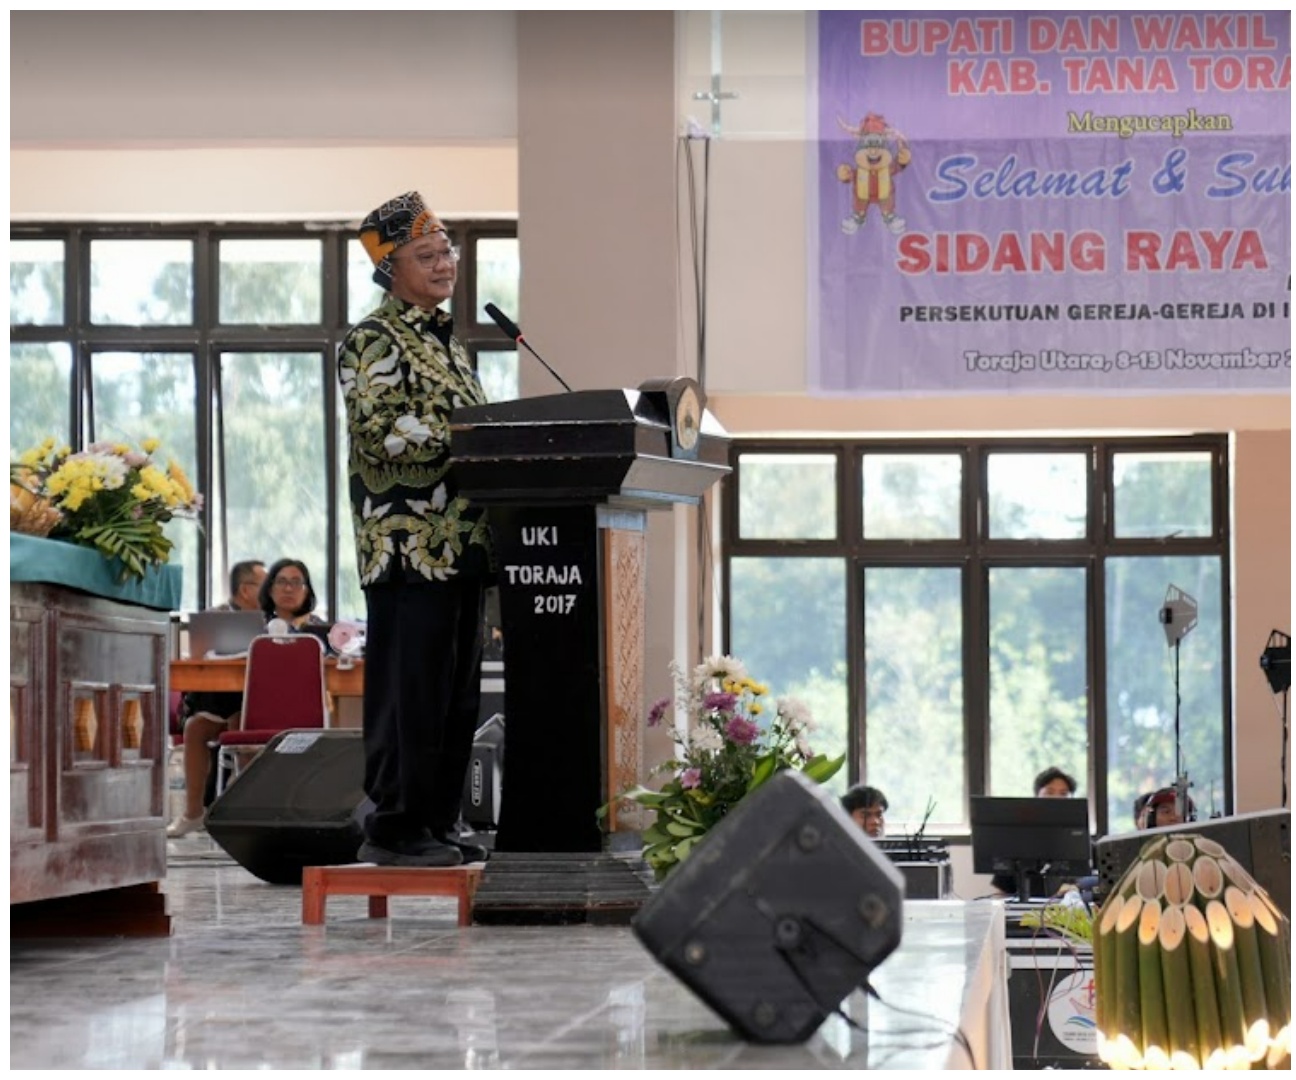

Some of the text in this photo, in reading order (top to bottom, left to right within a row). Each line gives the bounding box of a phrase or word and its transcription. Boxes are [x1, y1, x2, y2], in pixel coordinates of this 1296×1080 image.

[861, 14, 1277, 55] BUPATI DAN WAKIL
[948, 58, 1050, 95] KAB.
[1063, 57, 1177, 94] TANA
[1067, 108, 1234, 138] Mengucapkan
[928, 154, 1133, 203] Selamat
[1151, 147, 1189, 197] &
[897, 228, 1268, 275] SIDANG RAYA
[900, 304, 1060, 323] PERSEKUTUAN
[1067, 302, 1245, 321] GEREJA-GEREJA
[1252, 302, 1276, 319] DI
[964, 350, 1035, 373] Toraja
[1040, 350, 1112, 373] Utara,
[1116, 350, 1161, 371] 8-13
[1166, 347, 1281, 371] November
[521, 526, 558, 546] UKI
[505, 565, 582, 585] TORAJA
[534, 595, 577, 614] 2017
